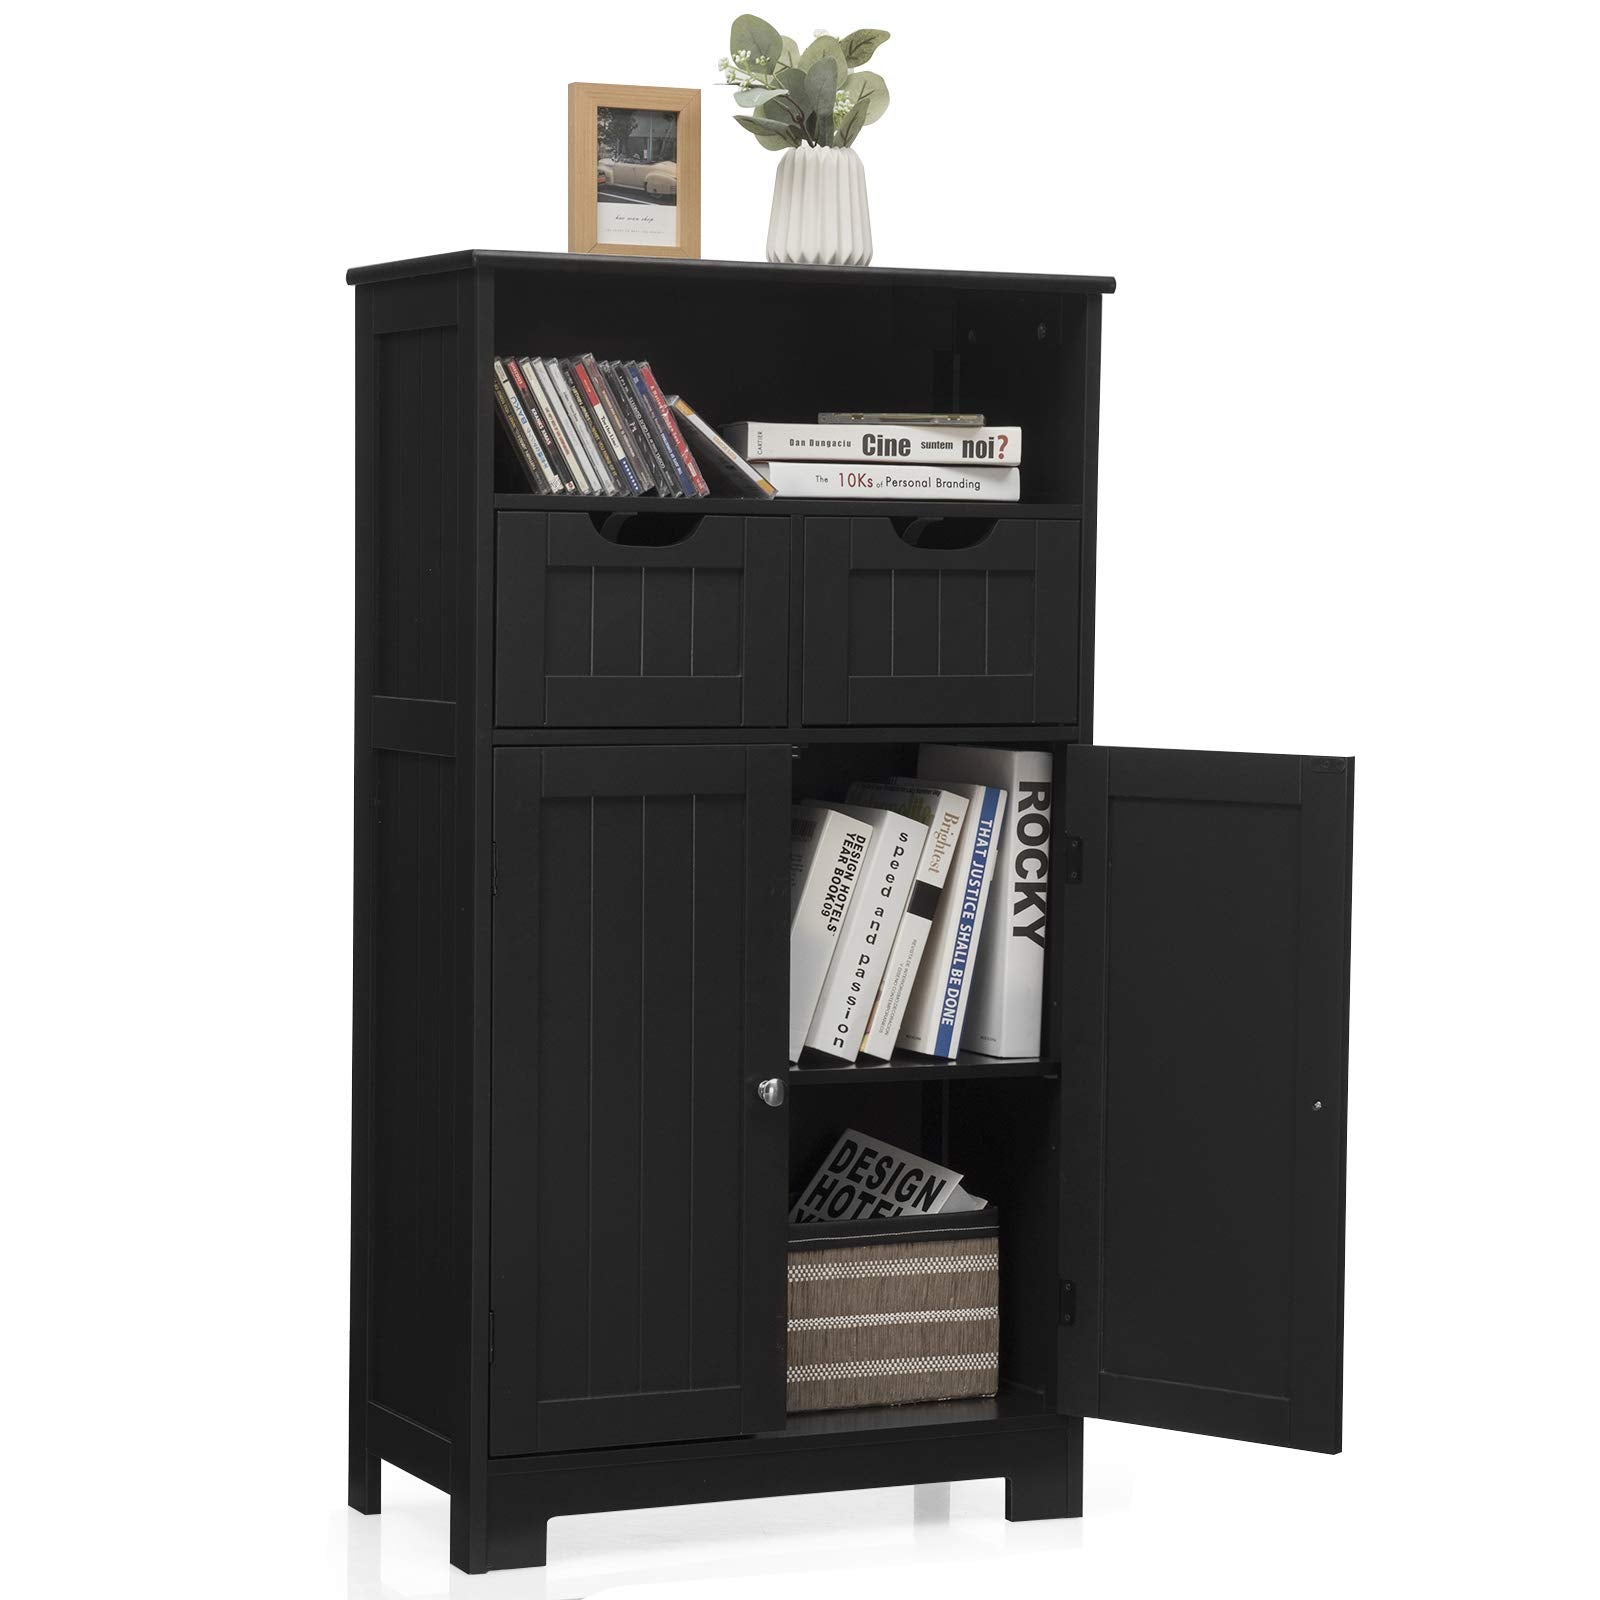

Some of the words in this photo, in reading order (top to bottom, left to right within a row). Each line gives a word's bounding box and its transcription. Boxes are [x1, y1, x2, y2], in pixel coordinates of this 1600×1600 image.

[511, 396, 527, 424] BAKU
[809, 439, 851, 448] Dungaciu
[862, 433, 911, 456] Cine
[921, 440, 953, 449] suntem
[962, 435, 1008, 459] noi?
[816, 475, 828, 483] The
[838, 473, 873, 487] 10Ks
[886, 477, 931, 488] Personal
[936, 478, 981, 490] Branding
[838, 832, 856, 863] YEAR
[848, 835, 866, 881] DESIGN
[927, 811, 960, 874] Brightest
[976, 820, 992, 856] THAT
[1013, 782, 1051, 950] ROCKY
[963, 861, 984, 920] JUSTICE
[954, 924, 972, 966] SHALL
[949, 968, 962, 985] BE
[833, 954, 871, 1048] passion
[941, 987, 959, 1026] DONE
[805, 1174, 903, 1219] HOTE
[828, 1139, 946, 1212] DESIGN
